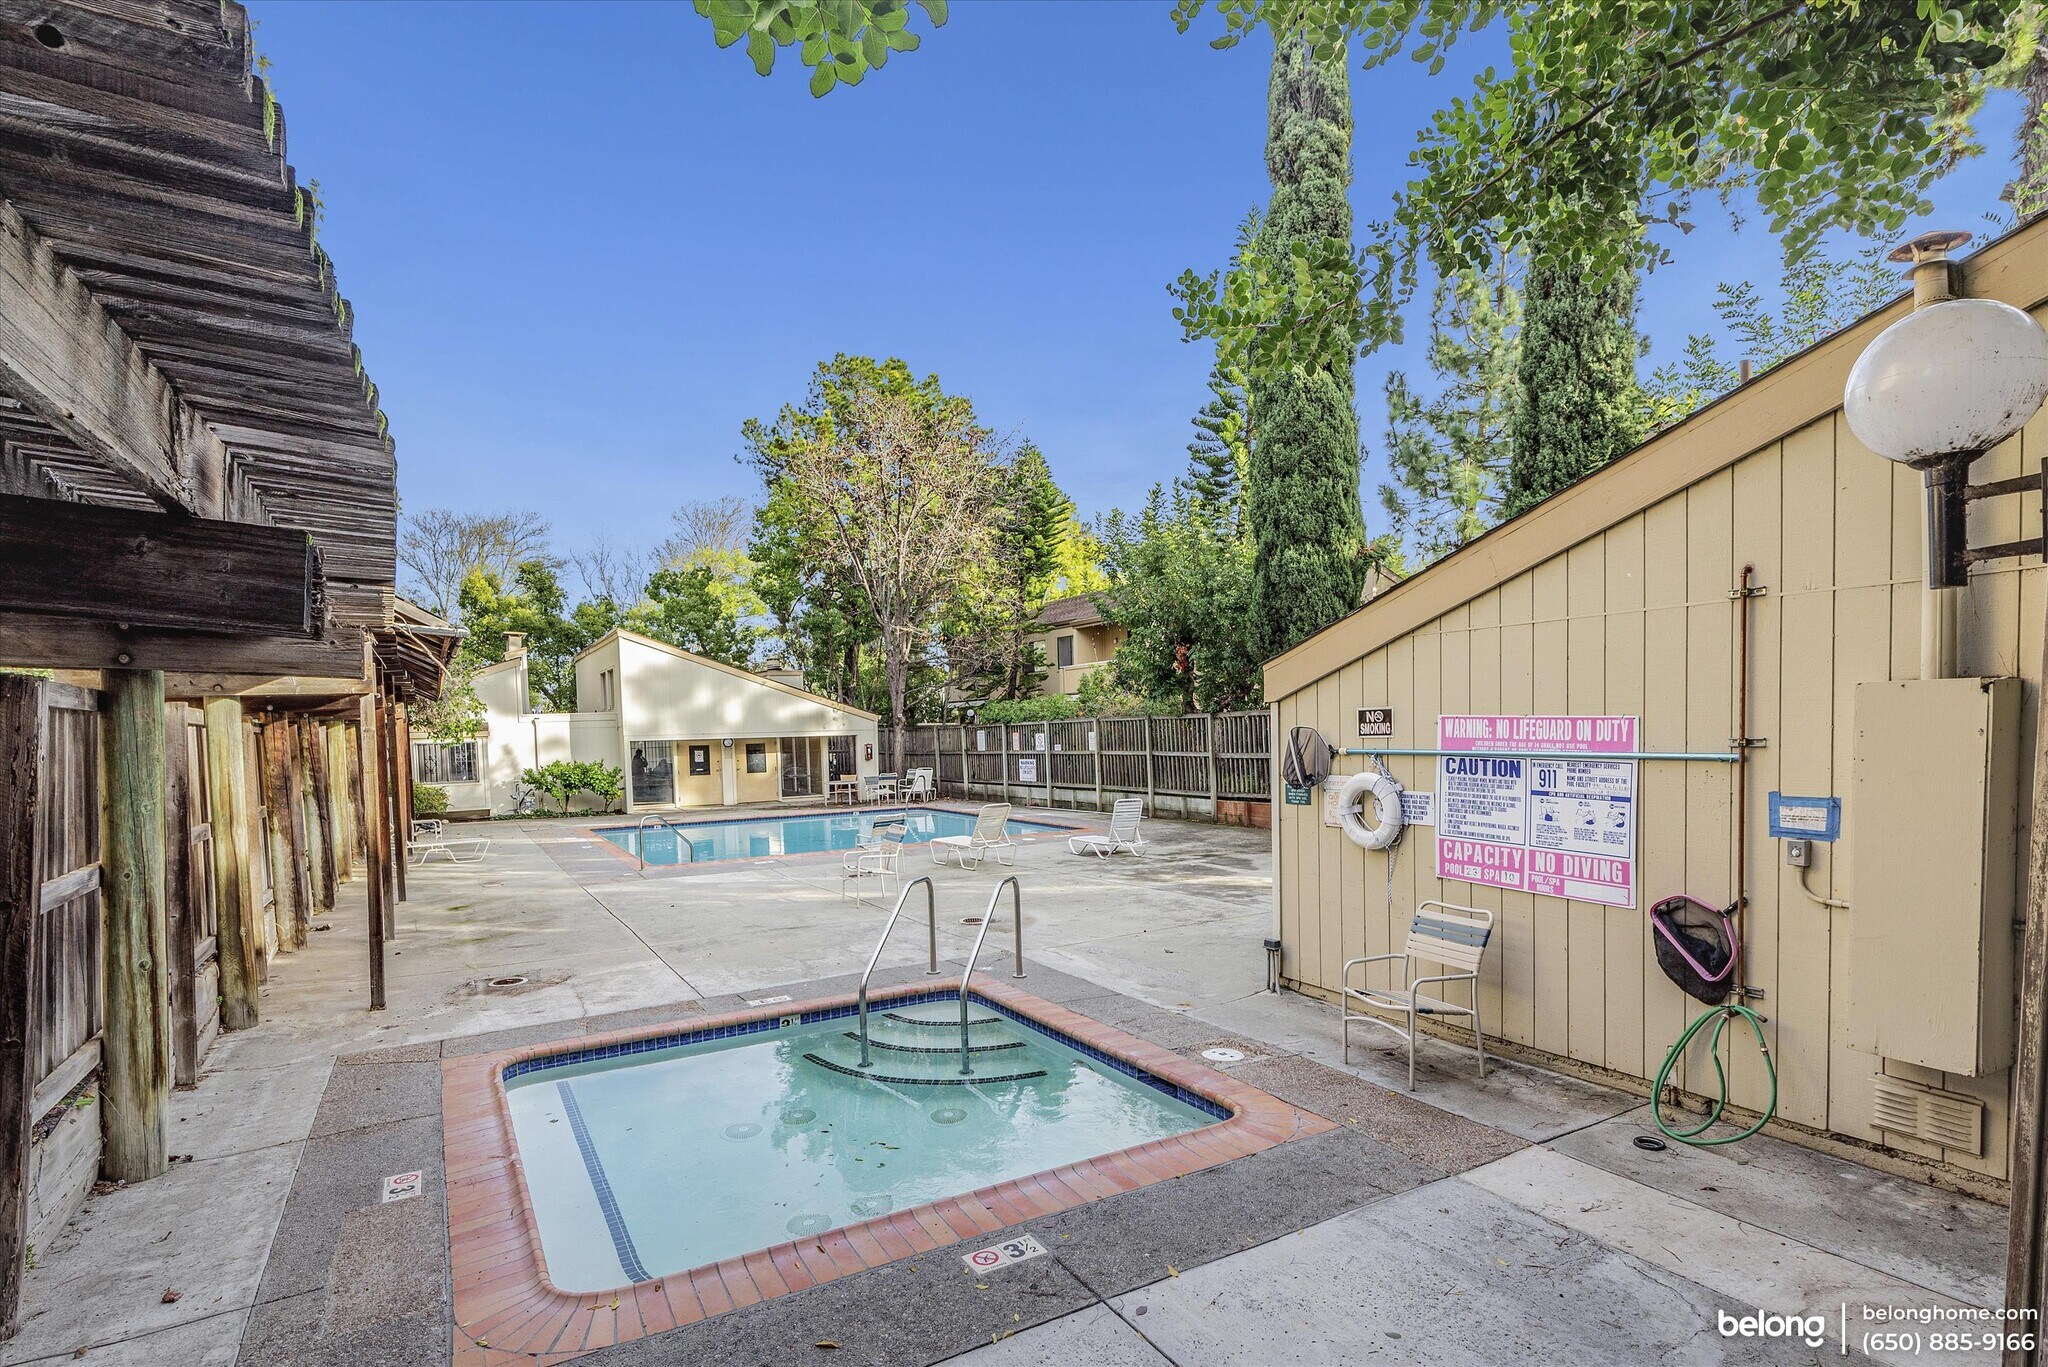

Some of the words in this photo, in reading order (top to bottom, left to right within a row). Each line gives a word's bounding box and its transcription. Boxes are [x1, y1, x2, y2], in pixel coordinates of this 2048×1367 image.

[1365, 710, 1384, 723] NO
[1360, 722, 1391, 735] SMOKING
[1444, 718, 1493, 739] WARNING:
[1496, 718, 1510, 740] NO
[1513, 718, 1572, 741] LIFEGUARD
[1576, 719, 1592, 742] ON
[1596, 719, 1630, 742] DUTY
[1445, 757, 1521, 779] CAUTION
[1539, 769, 1557, 789] 911
[1443, 840, 1523, 869] CAPACITY
[1444, 862, 1464, 876] POOL
[1483, 868, 1500, 882] SPA
[1504, 871, 1515, 882] 10
[1535, 851, 1556, 873] NO
[1563, 855, 1623, 883] DIVING
[1531, 874, 1560, 887] POOL/SPA
[1536, 883, 1554, 894] HOURS
